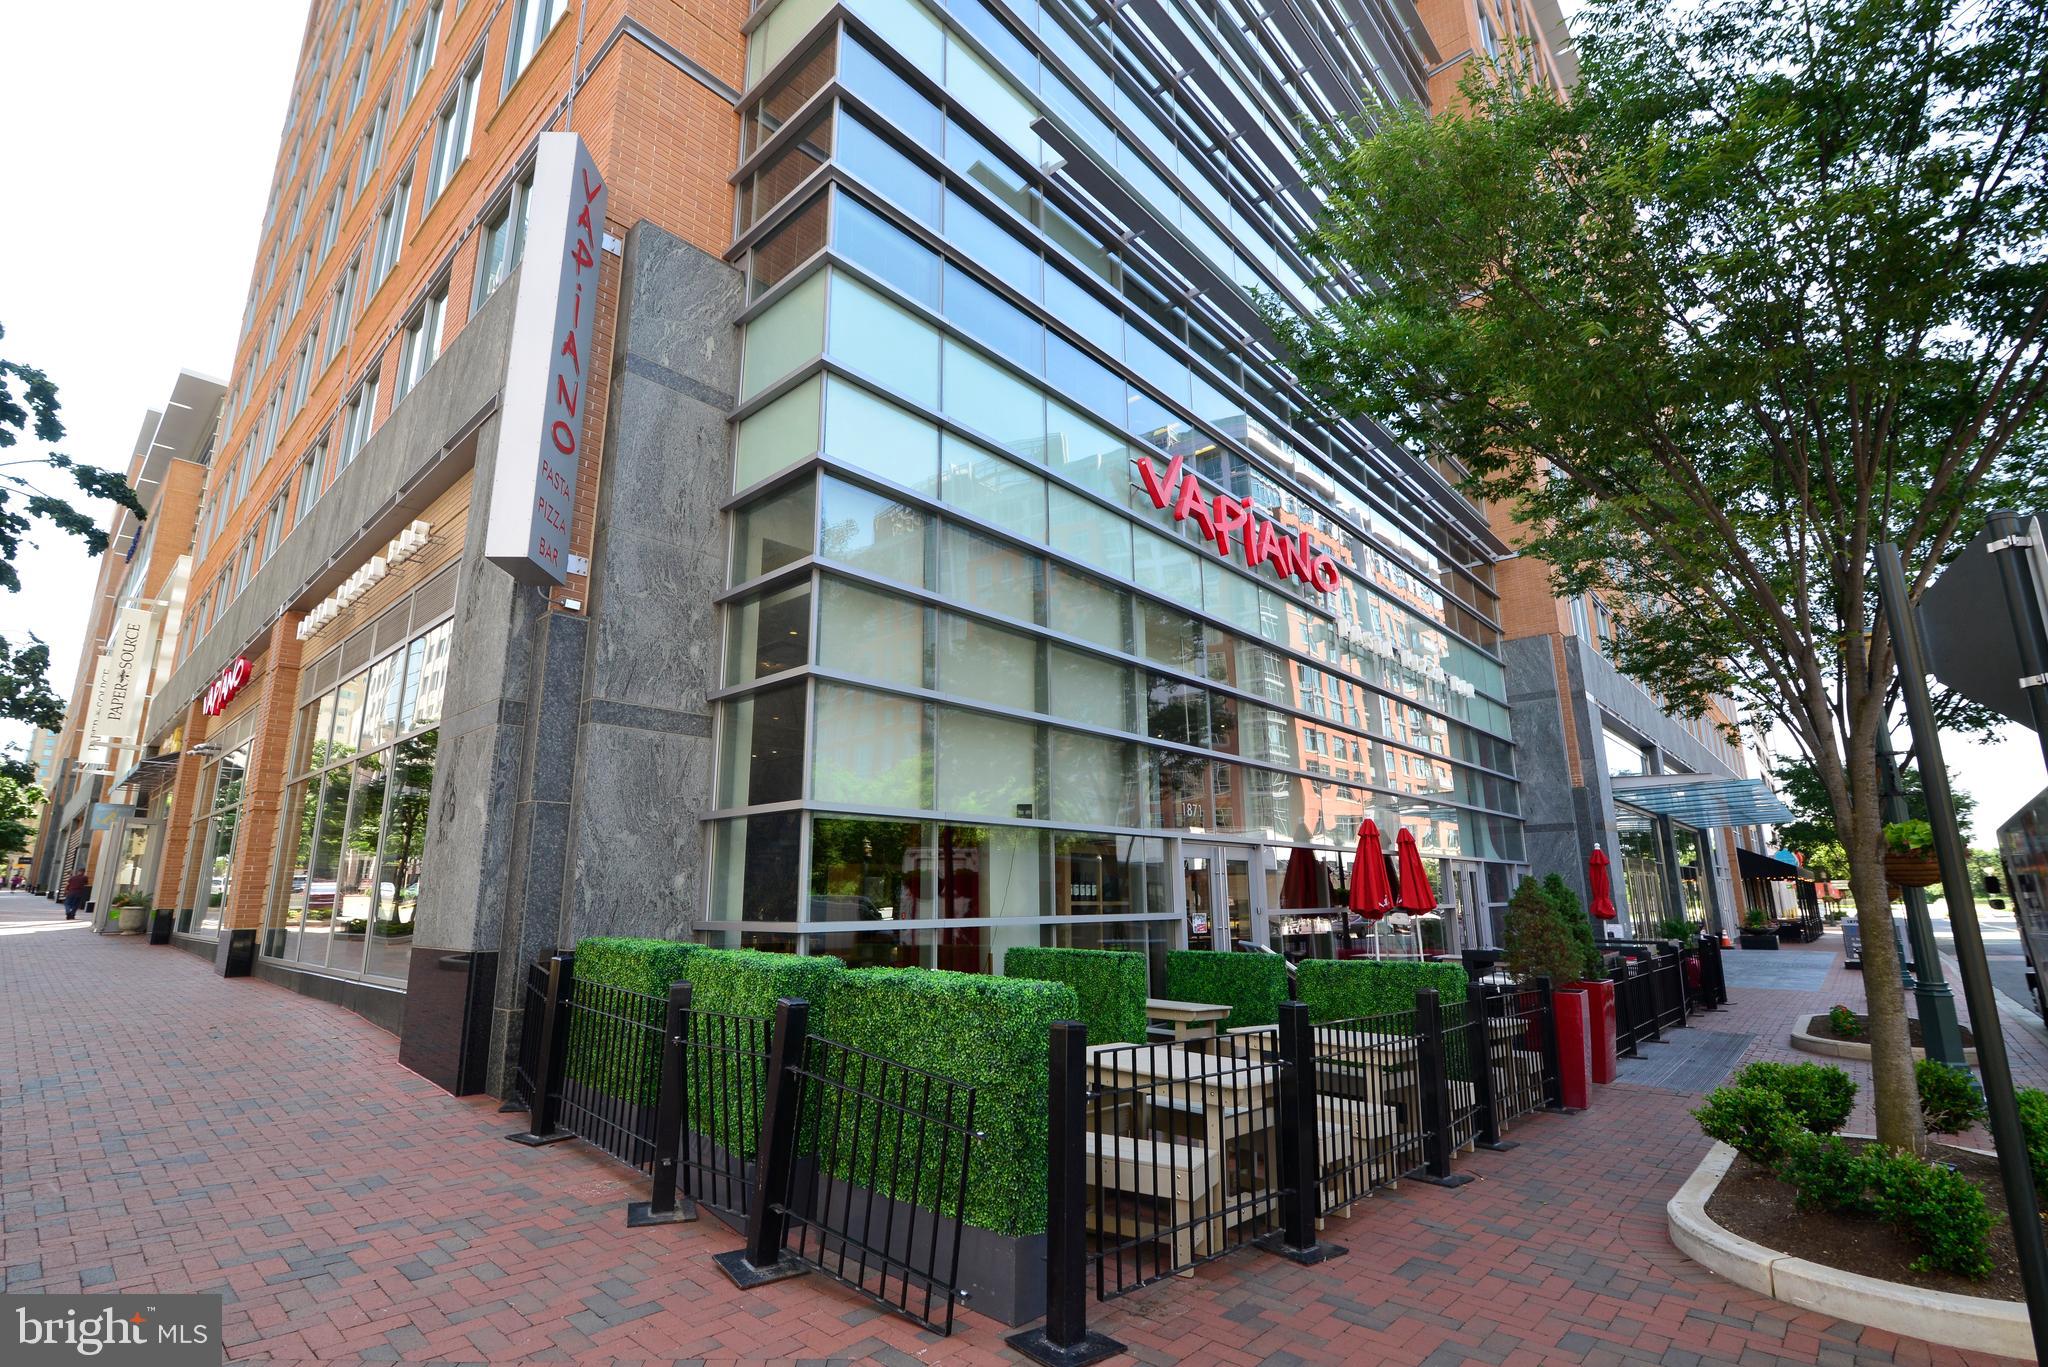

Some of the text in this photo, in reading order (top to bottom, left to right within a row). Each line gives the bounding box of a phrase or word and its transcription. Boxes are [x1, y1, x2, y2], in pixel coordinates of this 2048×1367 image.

[541, 460, 570, 501] PASTA
[538, 497, 566, 535] PIZZA
[539, 537, 558, 567] BAR
[107, 623, 141, 721] PAPER SOURCE
[1181, 802, 1203, 817] 1871
